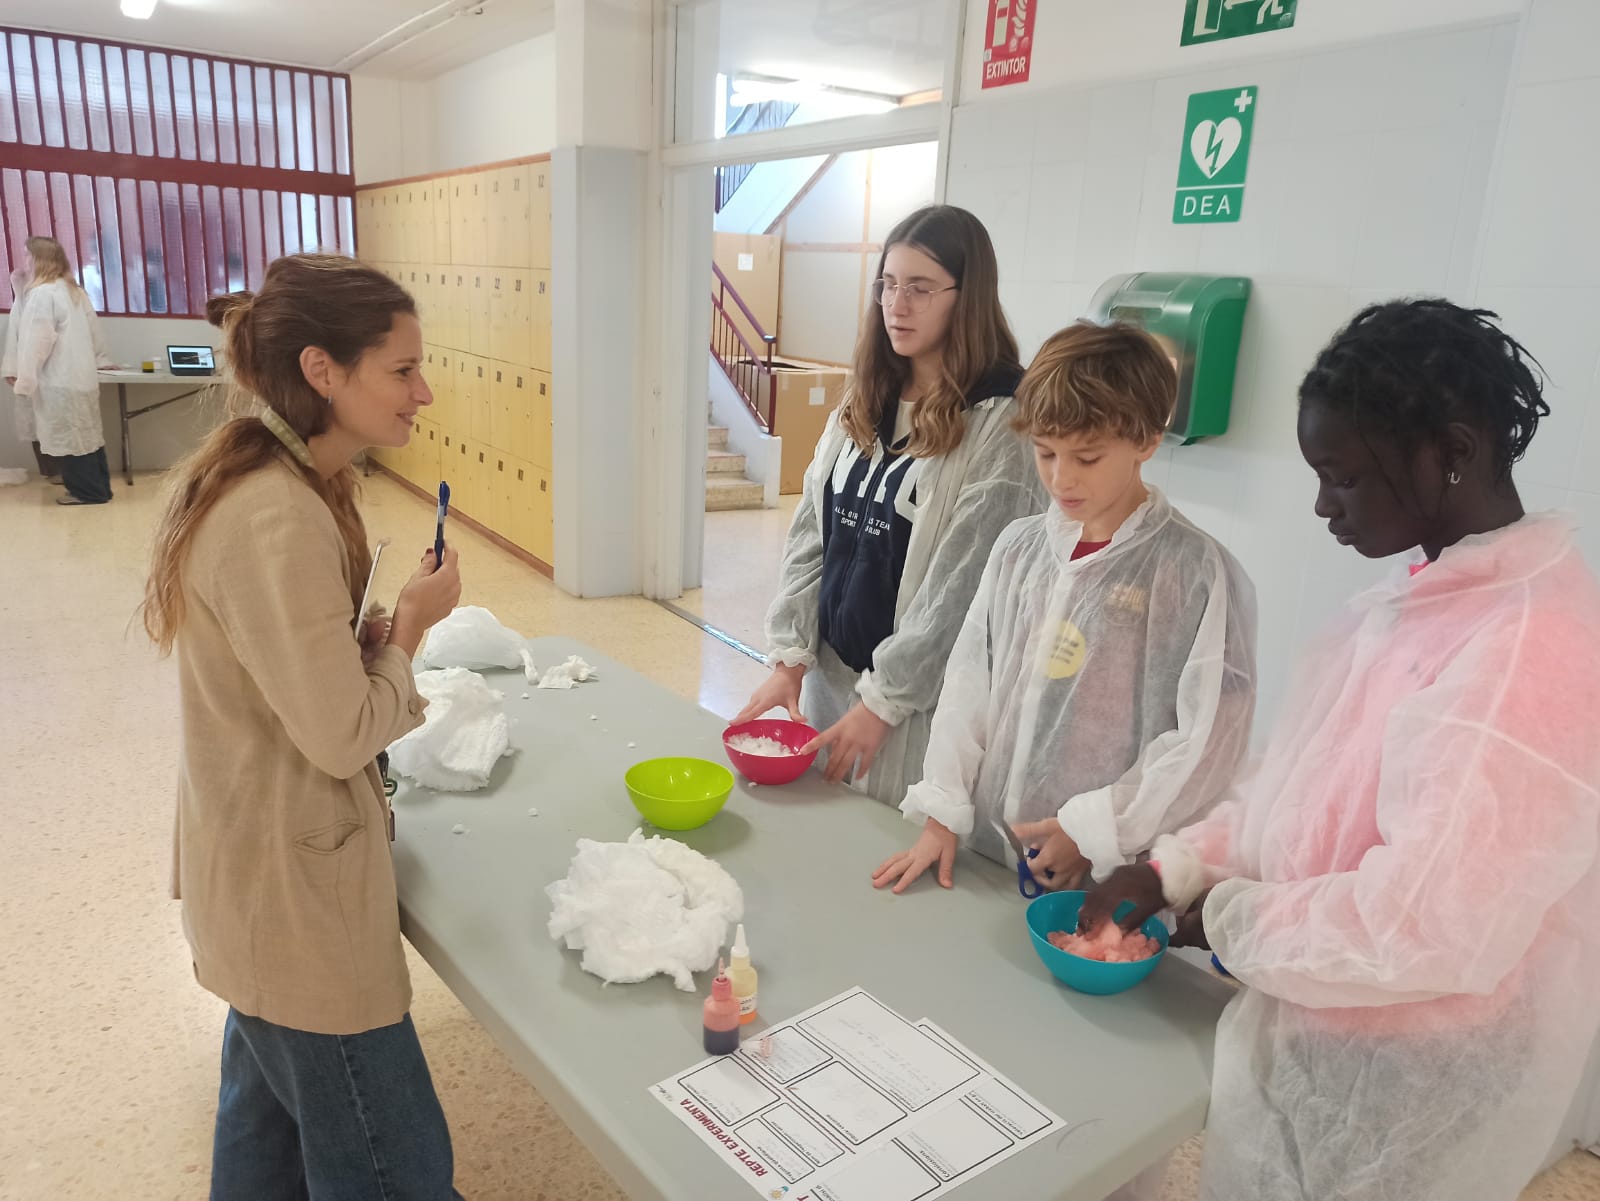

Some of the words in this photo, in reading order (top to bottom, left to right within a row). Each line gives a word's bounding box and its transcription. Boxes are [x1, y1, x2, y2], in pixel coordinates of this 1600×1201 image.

[986, 55, 1026, 80] EXTINTOR
[1182, 194, 1231, 217] DEA
[679, 1097, 739, 1151] EXPERIMENTA
[734, 1148, 769, 1177] REPTE
